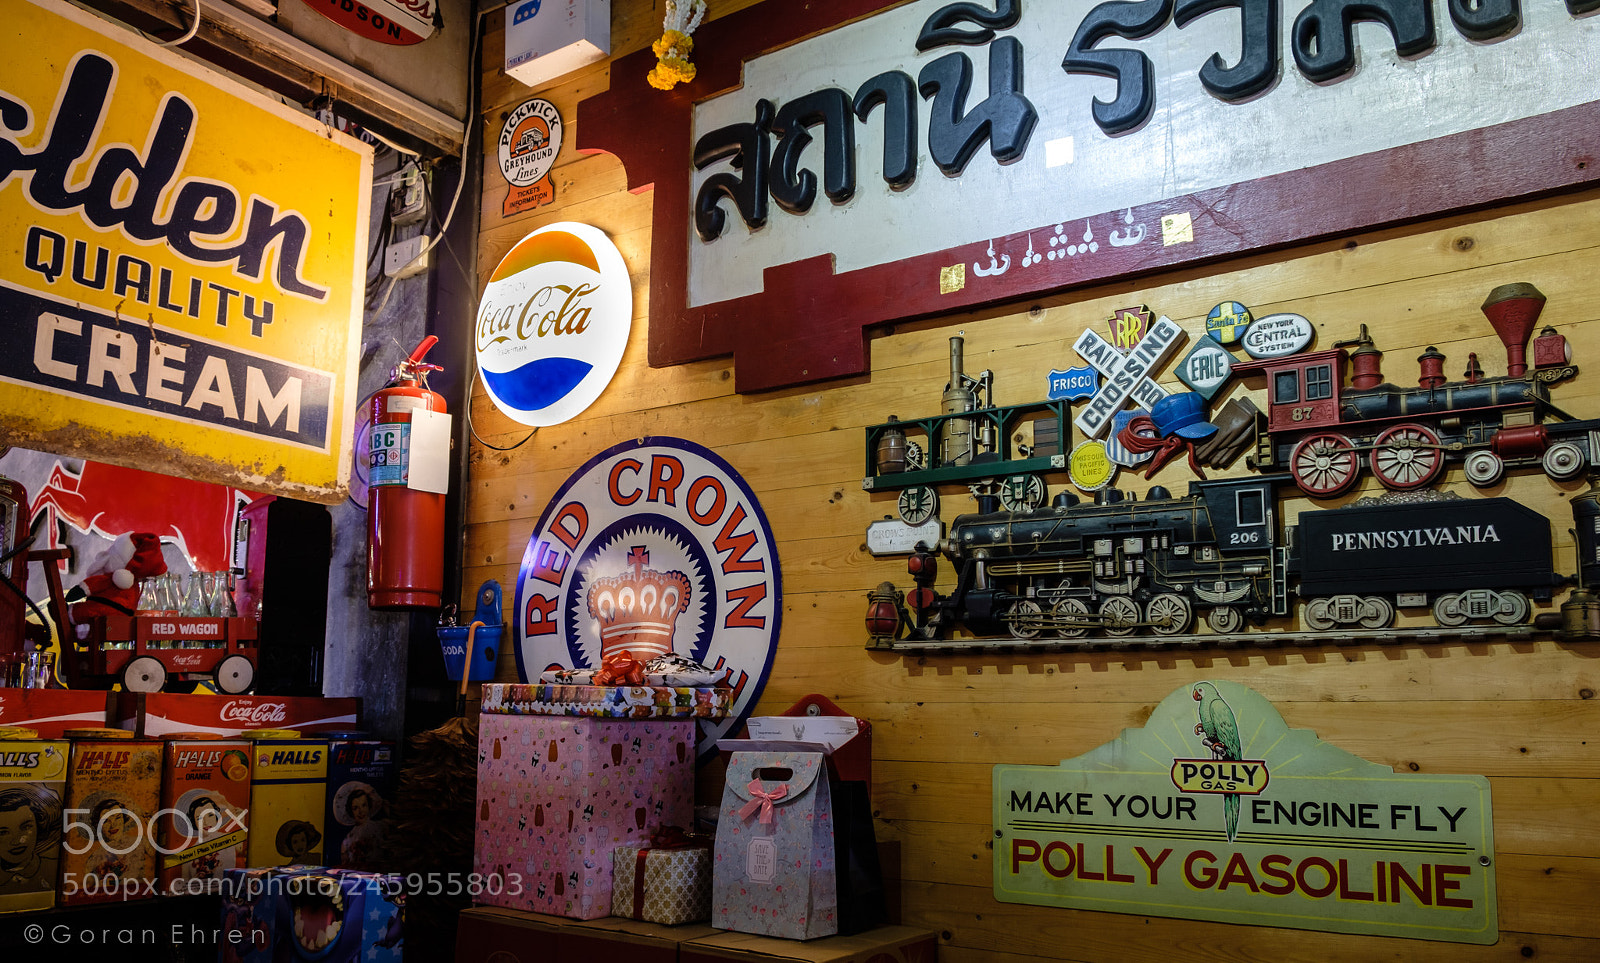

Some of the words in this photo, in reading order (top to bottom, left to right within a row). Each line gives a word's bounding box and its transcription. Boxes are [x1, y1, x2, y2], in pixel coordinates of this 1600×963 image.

[501, 102, 560, 146] PICKWICK
[504, 148, 553, 173] GREYHOUND
[512, 166, 541, 182] Lines
[509, 192, 548, 209] INFORMATION
[517, 186, 541, 198] TICKETS
[24, 226, 275, 338] QUALITY
[1207, 316, 1235, 329] Santa
[1237, 313, 1250, 325] Fe
[1258, 322, 1274, 331] NEW
[1276, 318, 1294, 327] YORK
[1246, 325, 1307, 347] CENTRAL
[1078, 332, 1120, 377] RAIL
[1258, 341, 1295, 353] SYSTEM
[33, 311, 302, 433] CREAM
[1190, 351, 1225, 382] ERIE
[1052, 374, 1092, 392] FRISCO
[1081, 321, 1176, 430] CROSSING
[1291, 406, 1314, 422] 87
[1080, 460, 1105, 469] PACIFIC
[1082, 467, 1102, 477] LINES
[524, 500, 590, 639] RED
[607, 453, 768, 631] CROWN
[1230, 532, 1260, 545] 206
[1330, 524, 1501, 552] PENNSYLVANIA
[152, 623, 176, 635] RED
[178, 623, 219, 635] WAGON
[442, 645, 465, 656] SODA
[219, 700, 288, 723] Coca-Cola
[76, 750, 131, 769] HALLS
[175, 750, 222, 768] HALLS
[271, 750, 322, 766] HALLS
[335, 749, 372, 765] HALLS
[185, 773, 212, 781] ORANGE
[1180, 763, 1260, 787] POLLY
[1200, 780, 1238, 792] GAS
[1009, 789, 1095, 817] MAKE
[1103, 793, 1198, 822] YOUR
[1251, 799, 1380, 830] ENGINE
[1390, 804, 1468, 833] FLY
[197, 846, 210, 855] Plus
[210, 838, 232, 850] Vitamin
[754, 844, 769, 854] SAVE
[755, 854, 767, 865] THE
[753, 864, 768, 875] DATE
[1010, 838, 1173, 886] POLLY
[1181, 850, 1474, 909] GASOLINE
